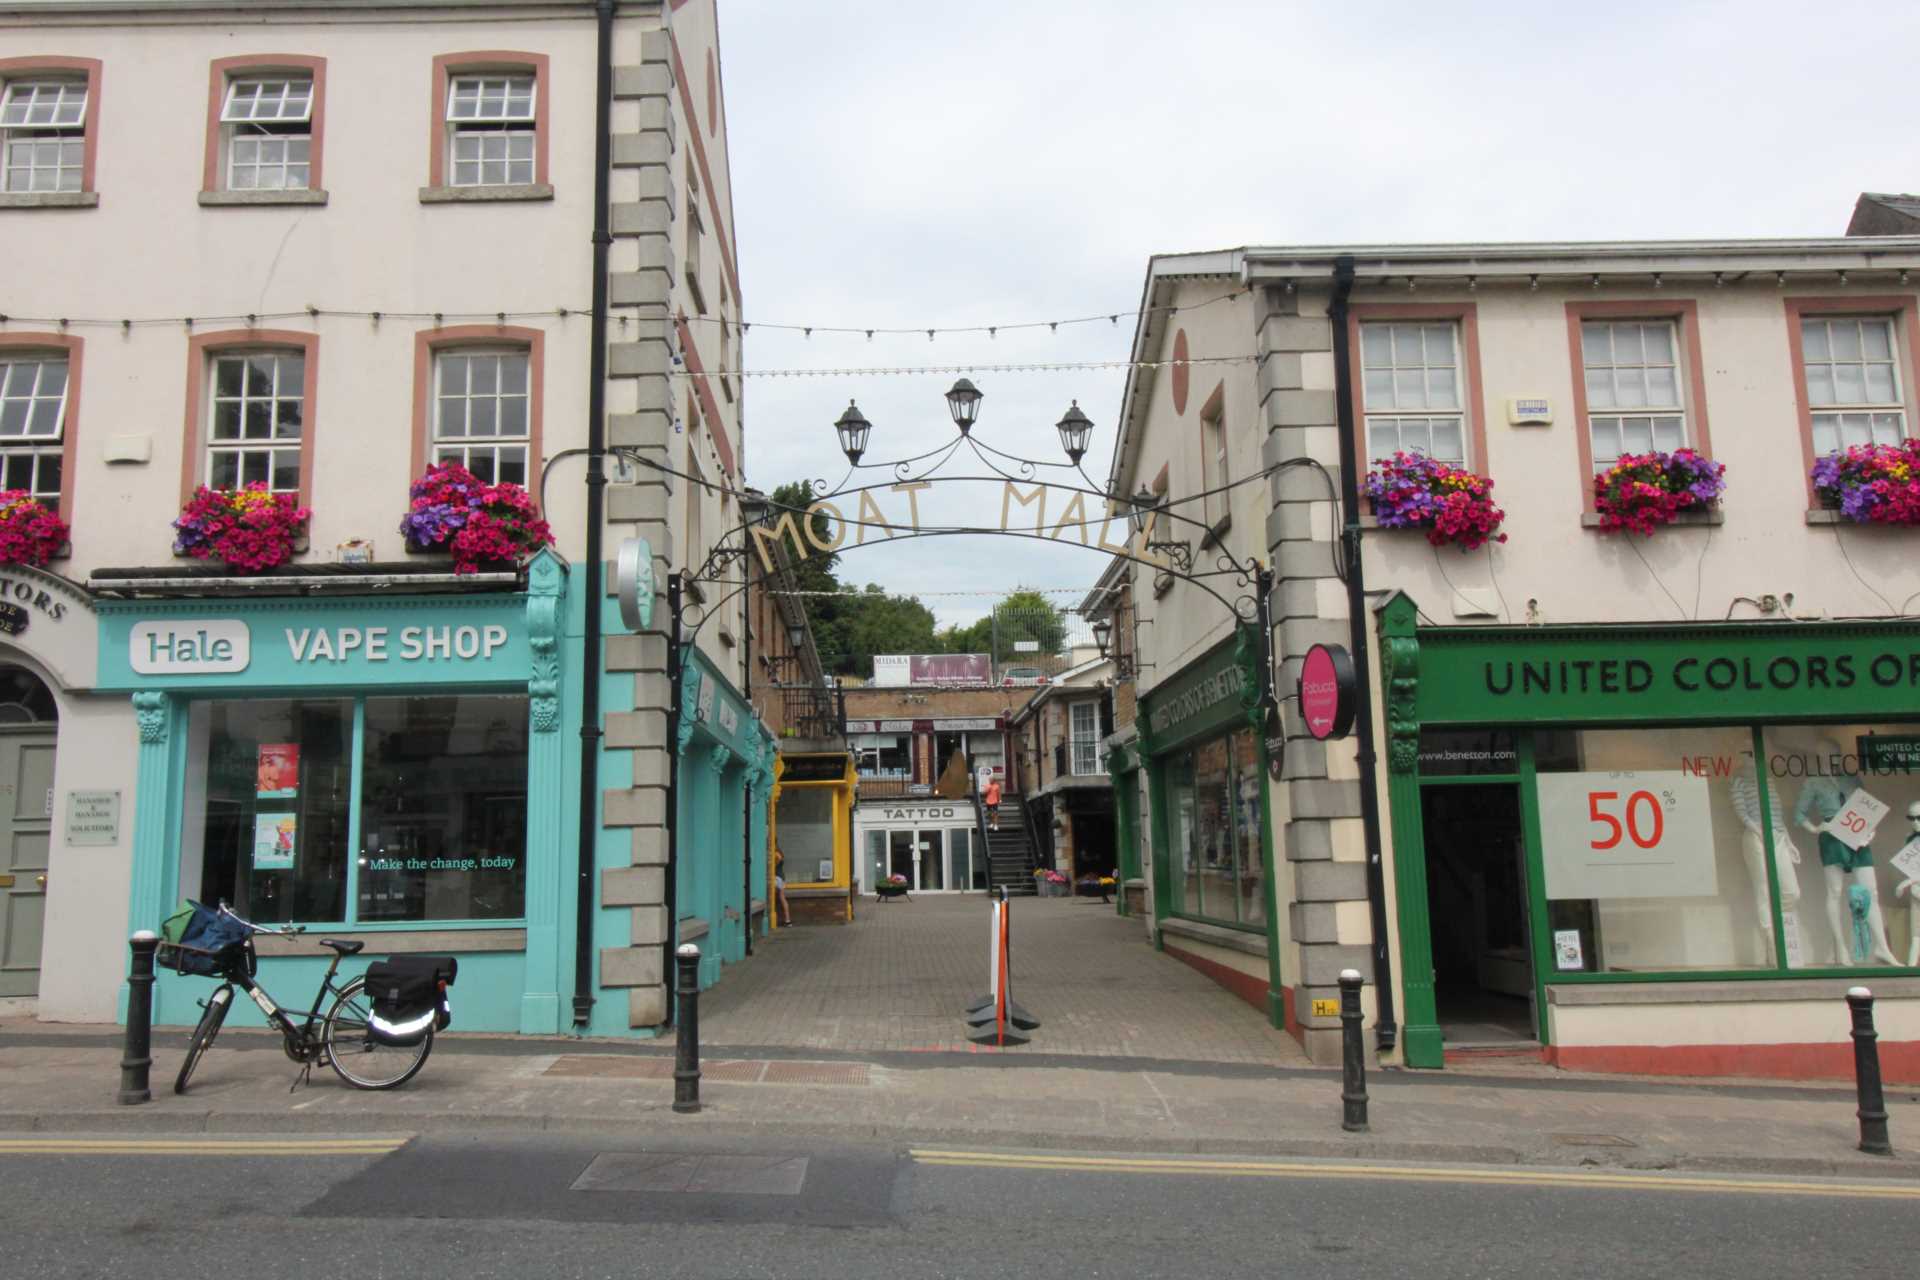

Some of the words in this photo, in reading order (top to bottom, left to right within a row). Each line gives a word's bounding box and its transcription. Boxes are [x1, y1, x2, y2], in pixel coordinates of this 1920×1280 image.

[750, 481, 932, 573] MOAT
[1001, 480, 1170, 570] MALL
[146, 630, 233, 663] Hale
[285, 627, 388, 663] VAPE
[399, 624, 508, 660] SHOP
[1485, 660, 1654, 694] UNITED
[1672, 655, 1856, 692] COLORS
[1417, 750, 1516, 761] www.benetton.com
[1876, 743, 1913, 753] UNITED
[1682, 756, 1732, 777] NEW
[1771, 754, 1910, 777] COLLECTION
[883, 808, 954, 819] TATTOO
[1841, 810, 1866, 833] 50
[370, 859, 403, 870] Make
[407, 858, 427, 869] the
[430, 857, 478, 871] change,
[481, 857, 515, 870] today
